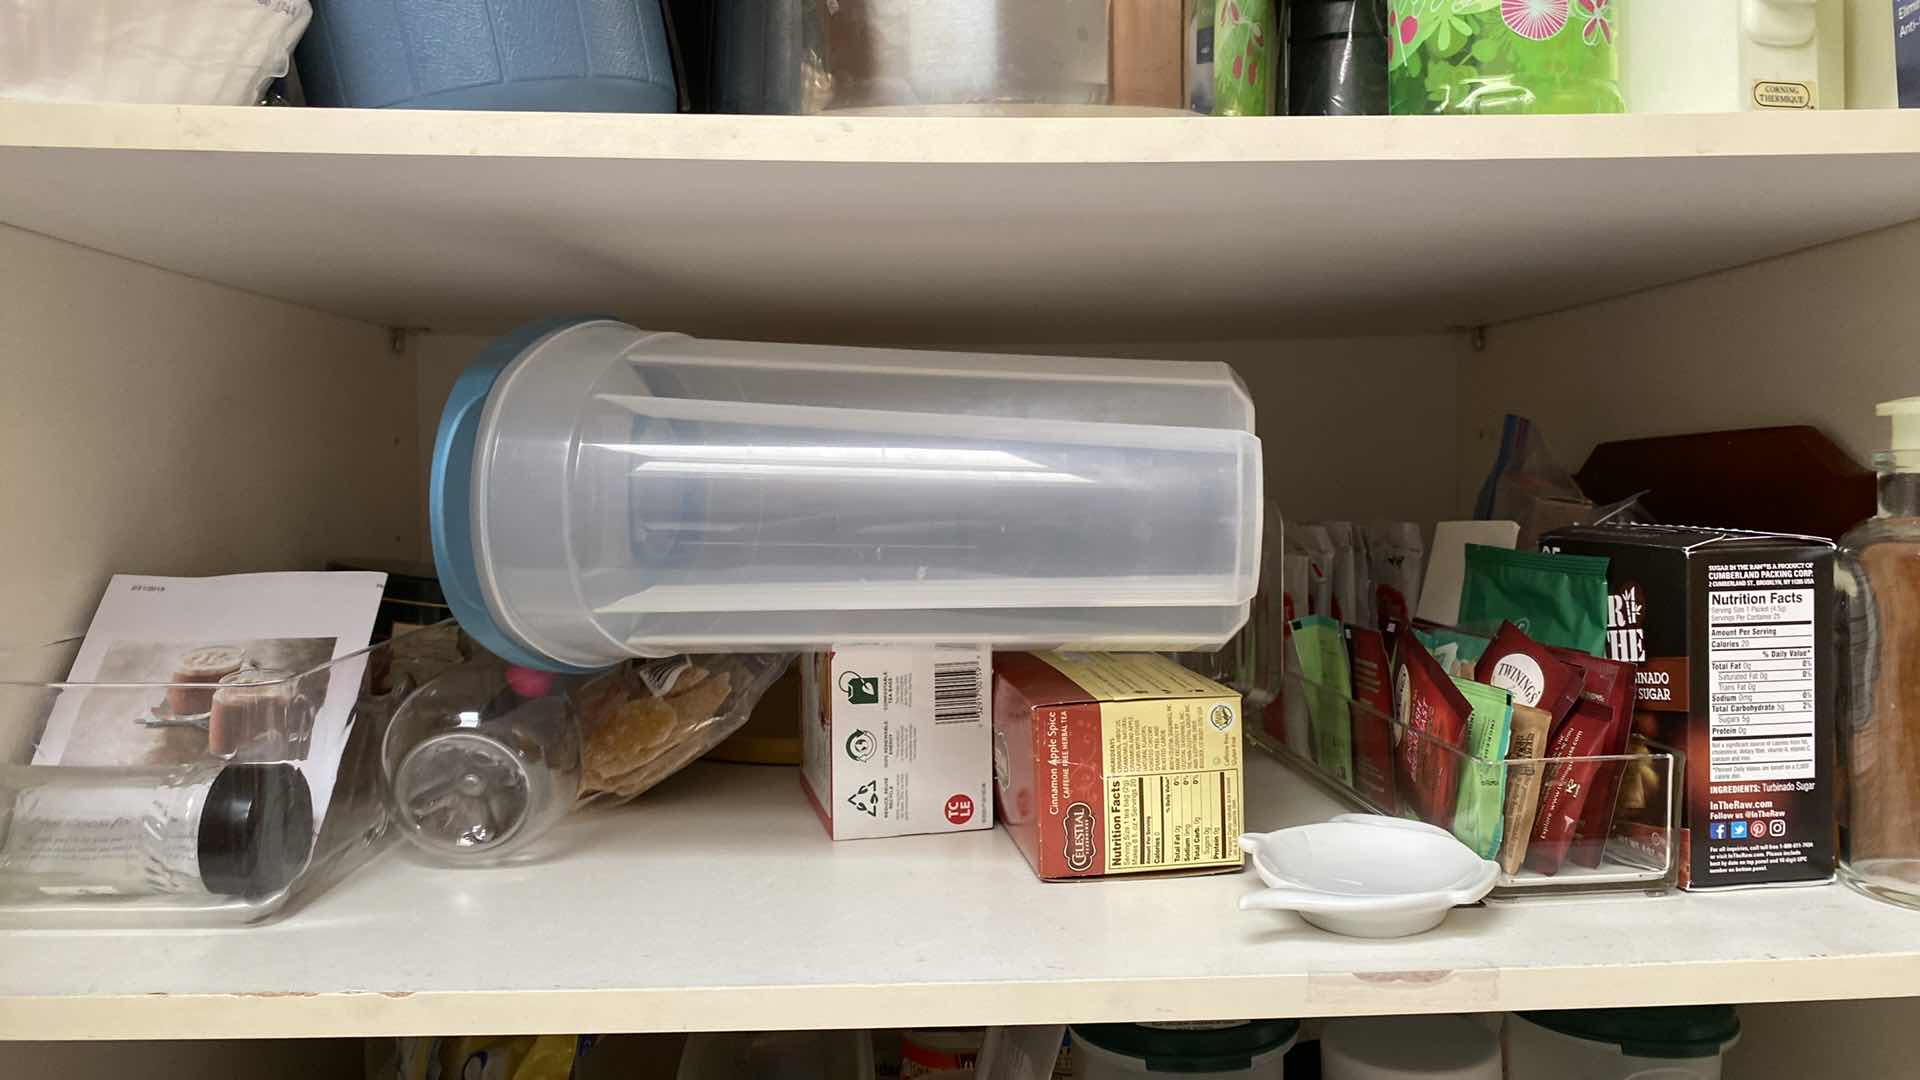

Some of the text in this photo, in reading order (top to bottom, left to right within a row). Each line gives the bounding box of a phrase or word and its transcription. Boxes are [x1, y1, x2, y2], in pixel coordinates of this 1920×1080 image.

[1765, 85, 1799, 94] CORNING
[1760, 94, 1805, 103] THERMIQUE
[1761, 570, 1792, 578] PACKING
[1712, 592, 1803, 606] Nutrition Facts
[1771, 650, 1787, 658] Daily
[1498, 662, 1538, 704] TWININGS
[1634, 671, 1669, 687] INADO
[1638, 687, 1671, 702] SUGAR
[1731, 704, 1775, 712] Carbohydrate
[1061, 724, 1069, 750] HERBAL
[1047, 712, 1060, 815] Cinnamon Apple Spice
[1710, 782, 1816, 794] INGREDIENTS: Turbinado Sugar
[1111, 781, 1121, 813] Facts
[1122, 795, 1131, 807] bag
[1130, 790, 1138, 817] Servings
[948, 801, 959, 818] TC
[960, 801, 970, 816] LE
[1710, 801, 1773, 810] InTheRaw.com
[1123, 809, 1131, 819] tea
[1710, 812, 1733, 820] Follow
[1745, 810, 1785, 819] @InTheRaw
[1123, 826, 1131, 840] Size
[1540, 812, 1553, 840] Explore
[1072, 809, 1087, 866] CELESTIAL
[1111, 816, 1122, 866] Nutrition
[1124, 842, 1132, 866] Serving
